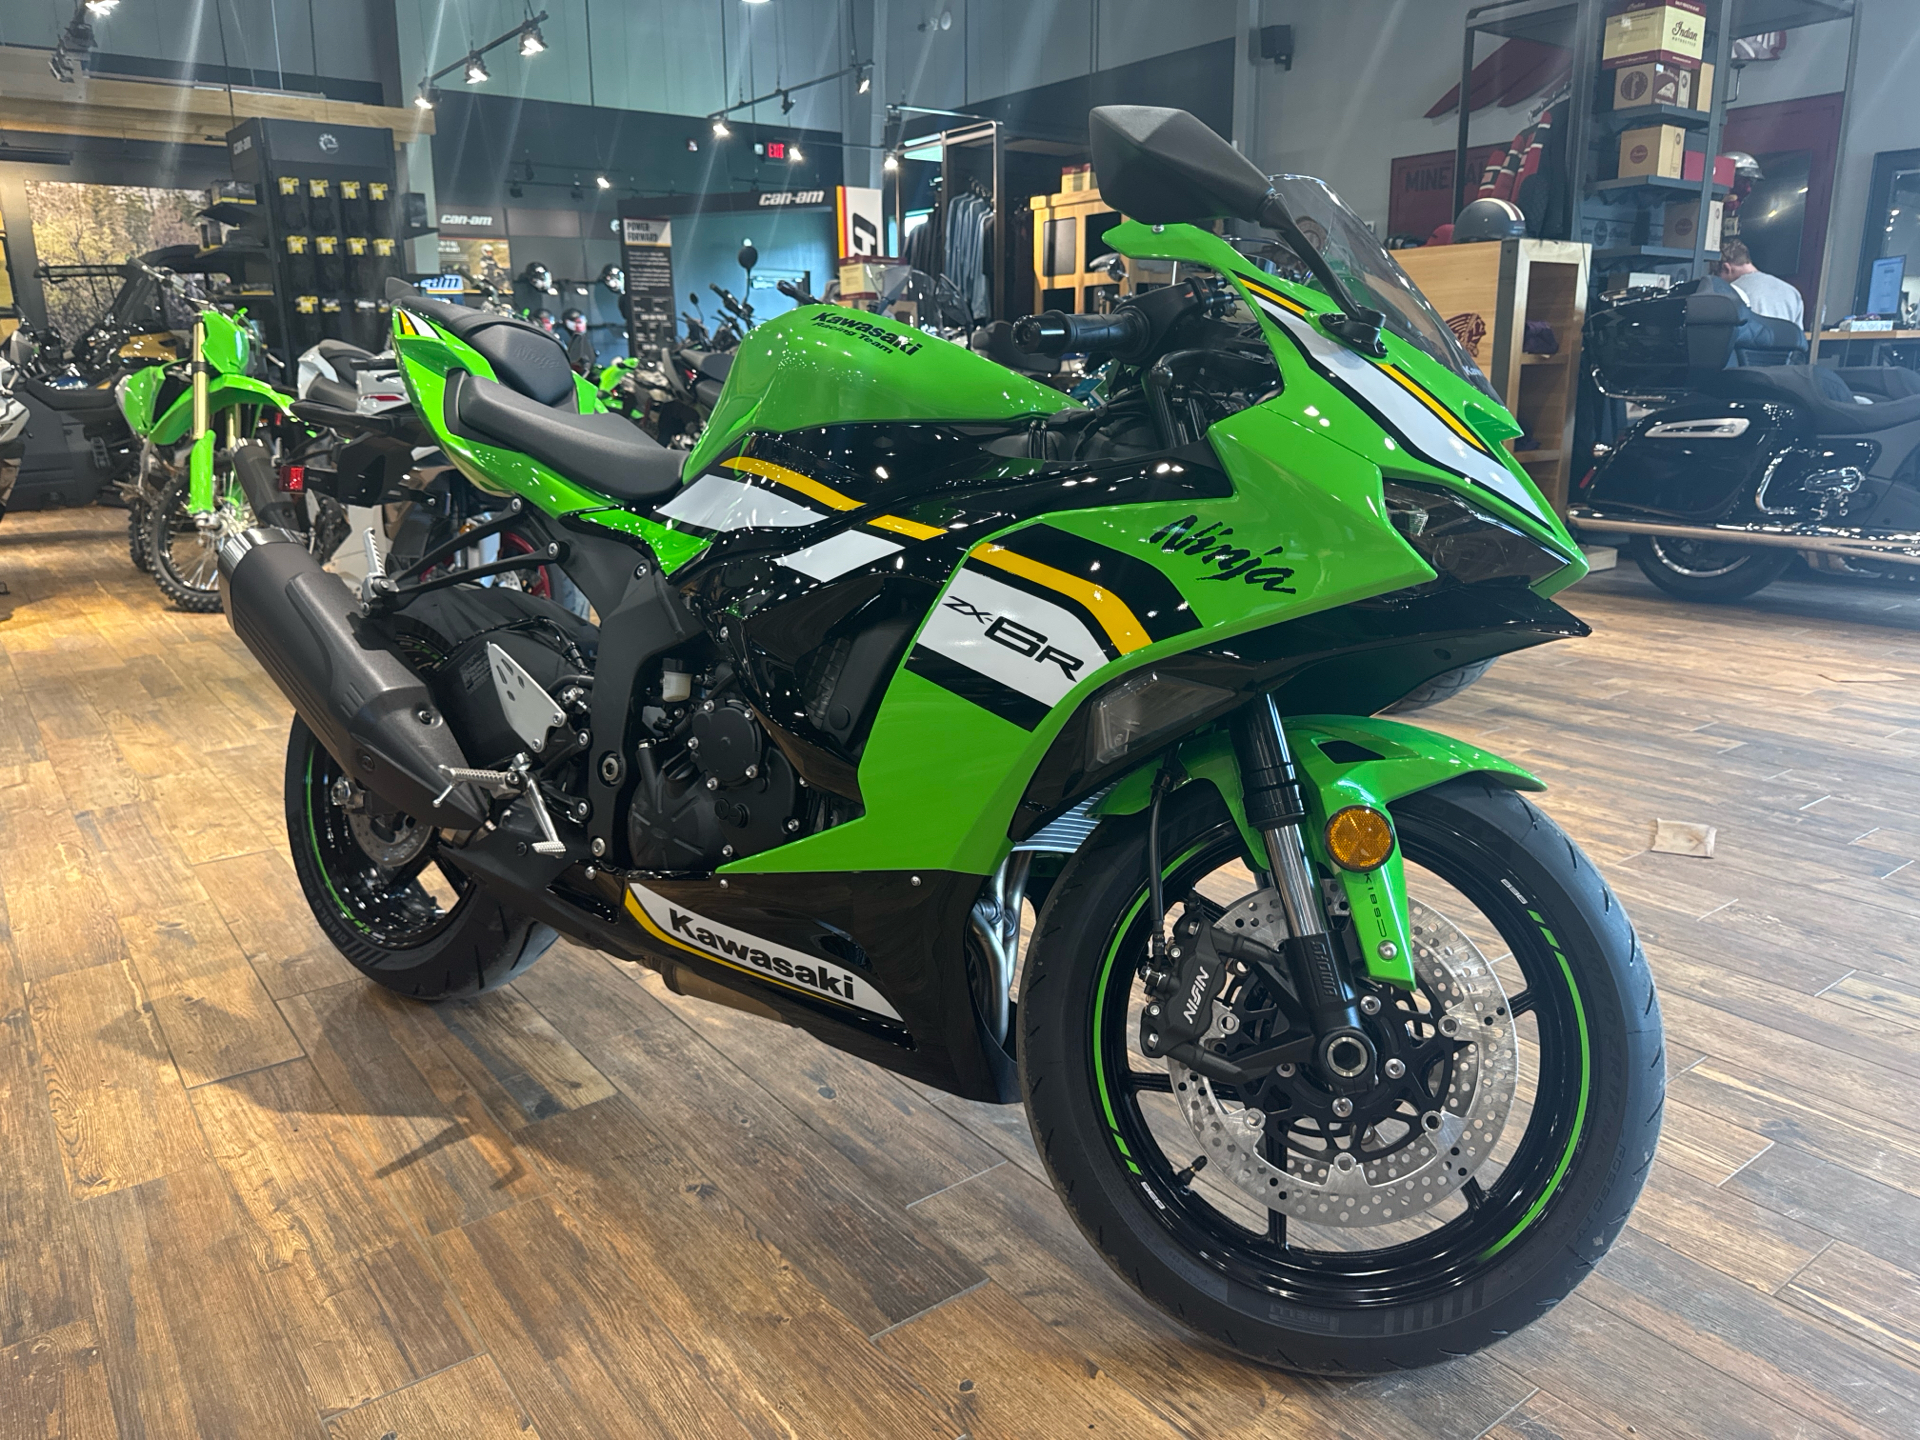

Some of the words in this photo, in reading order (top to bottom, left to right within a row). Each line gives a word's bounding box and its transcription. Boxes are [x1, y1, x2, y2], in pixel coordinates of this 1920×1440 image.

[1671, 21, 1699, 41] Indian
[767, 142, 785, 159] EXIT
[758, 190, 825, 206] can-am
[440, 214, 494, 226] can-am
[811, 312, 923, 356] Kawasaki
[812, 322, 857, 336] Racing
[859, 333, 893, 354] Team
[1149, 514, 1297, 594] Ninja
[669, 908, 854, 1000] Kawasaki
[1183, 965, 1210, 1025] NISSIN
